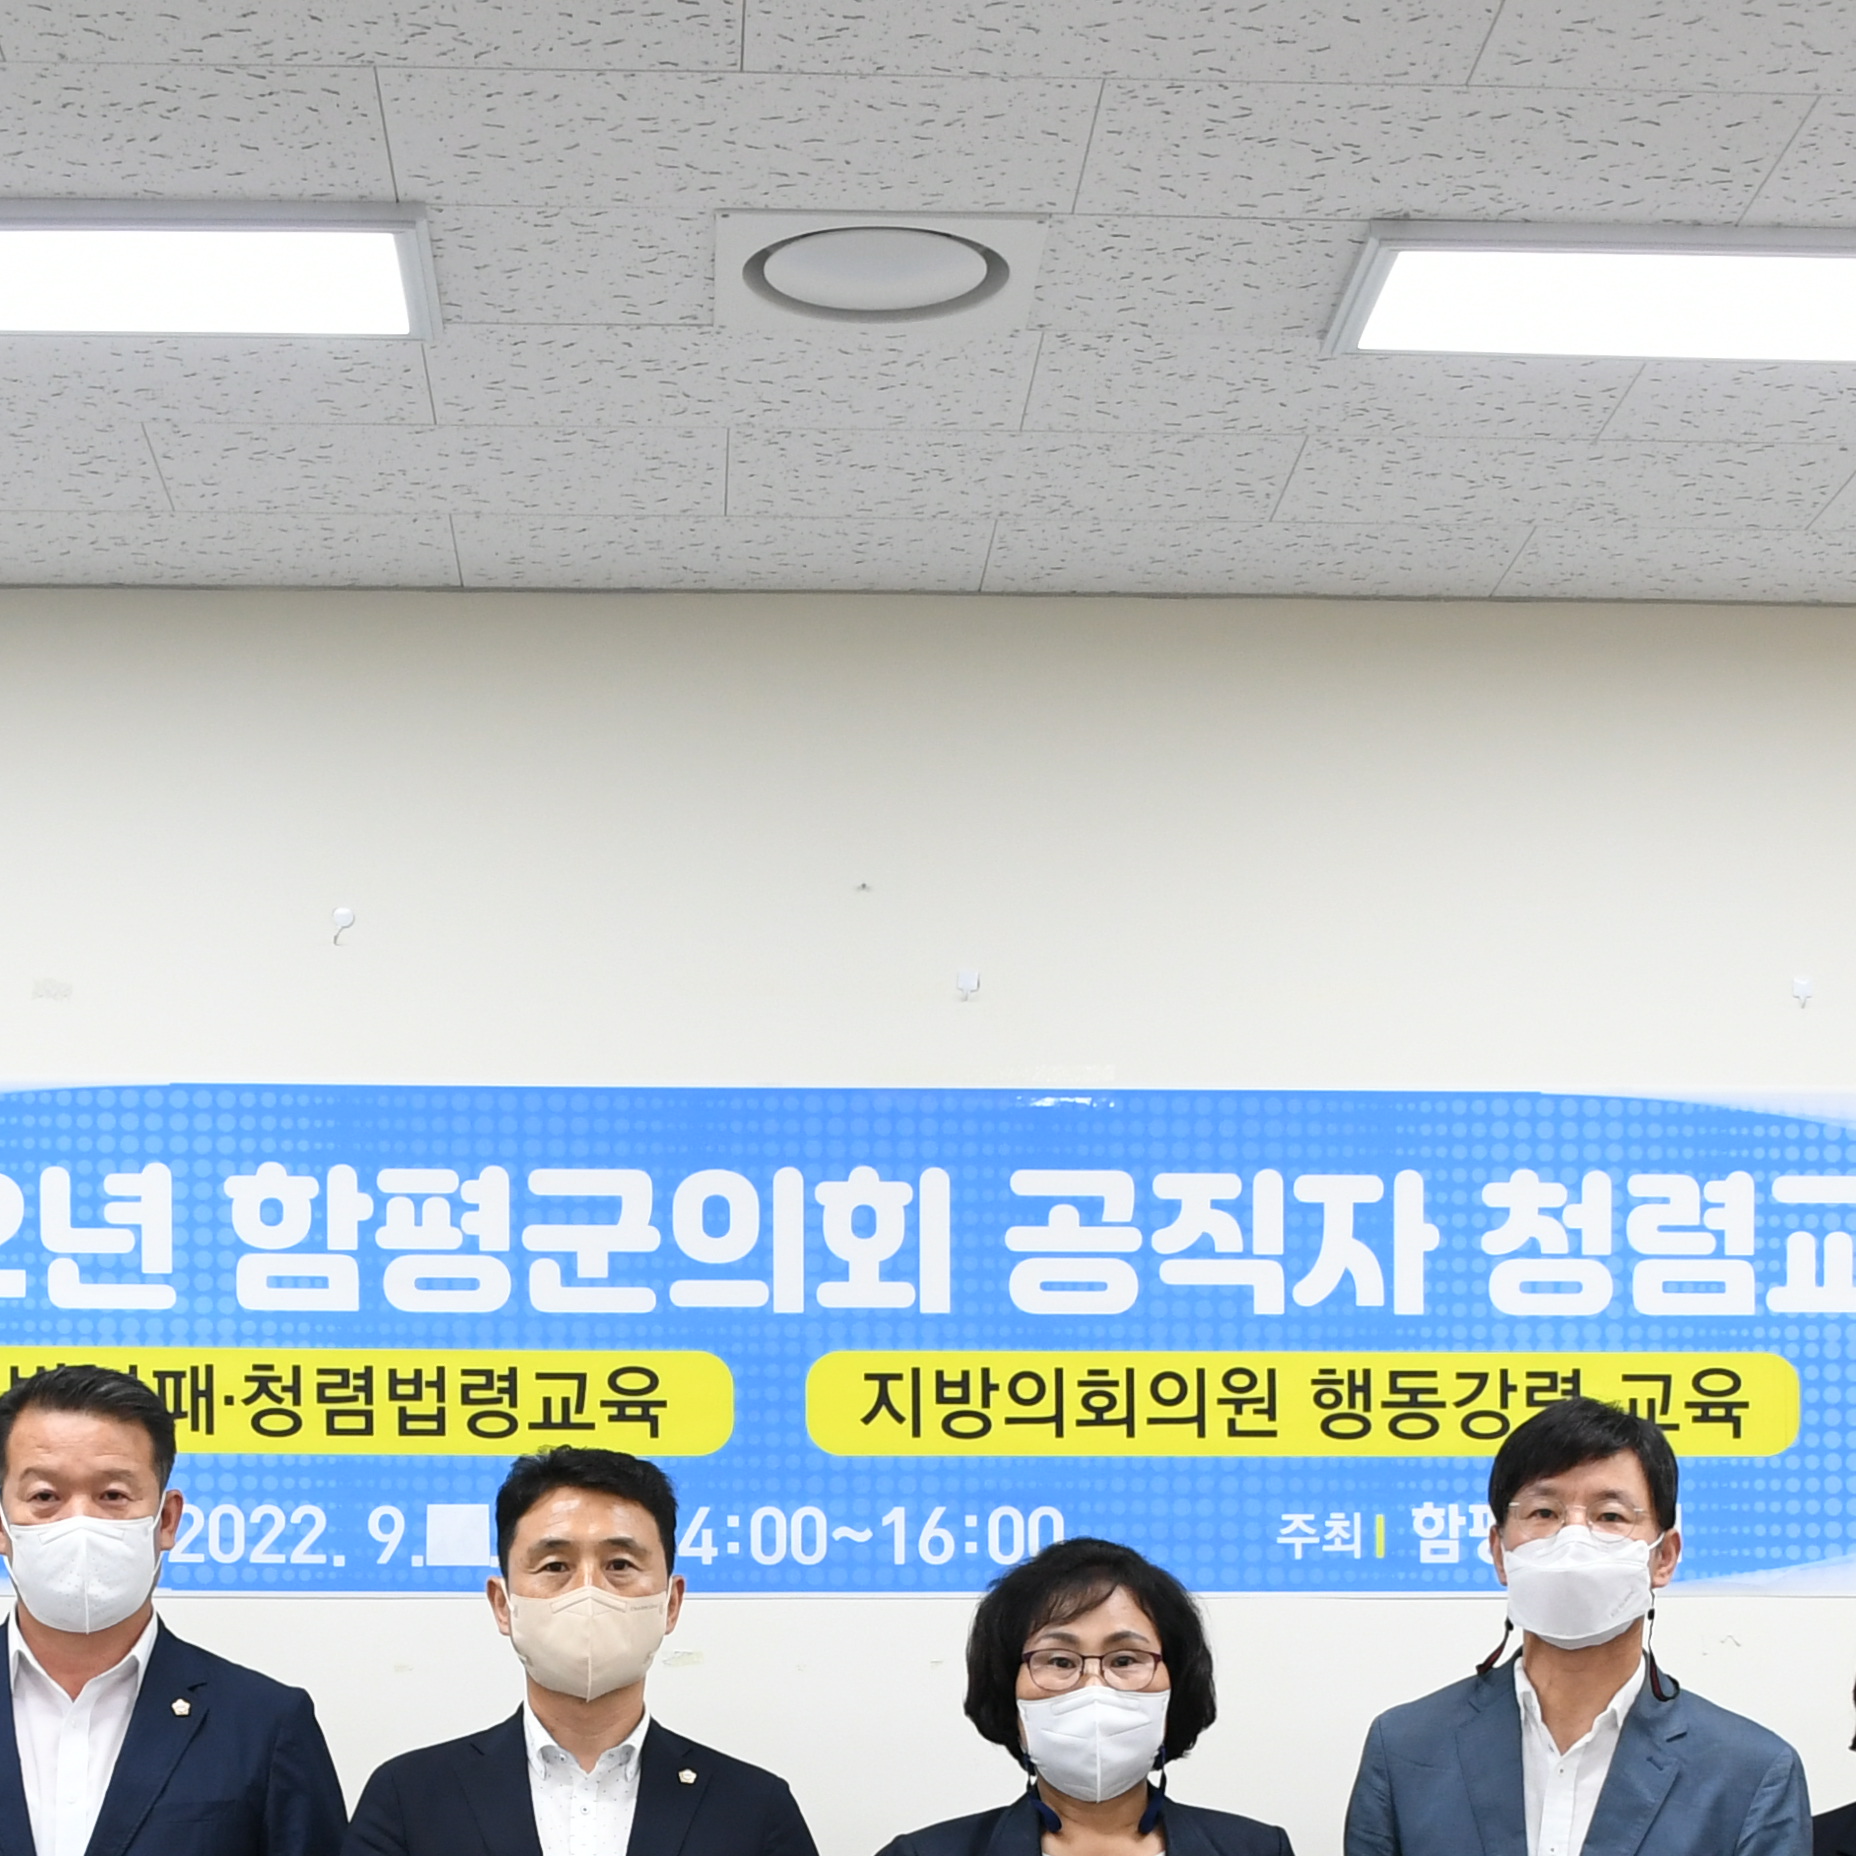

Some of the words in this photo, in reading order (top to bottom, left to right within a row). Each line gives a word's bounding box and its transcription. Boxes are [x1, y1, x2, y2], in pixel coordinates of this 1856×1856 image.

[224, 1161, 950, 1314] 함평군의회
[1005, 1168, 1441, 1316] 공직자
[10, 1362, 666, 1438] 패·청렴법령교육
[858, 1366, 1278, 1439] 지방의회의원
[1620, 1367, 1751, 1441] 교육
[170, 1504, 346, 1568] 2022.
[677, 1505, 1065, 1566] 4:00~16:00
[1276, 1512, 1362, 1560] 주최
